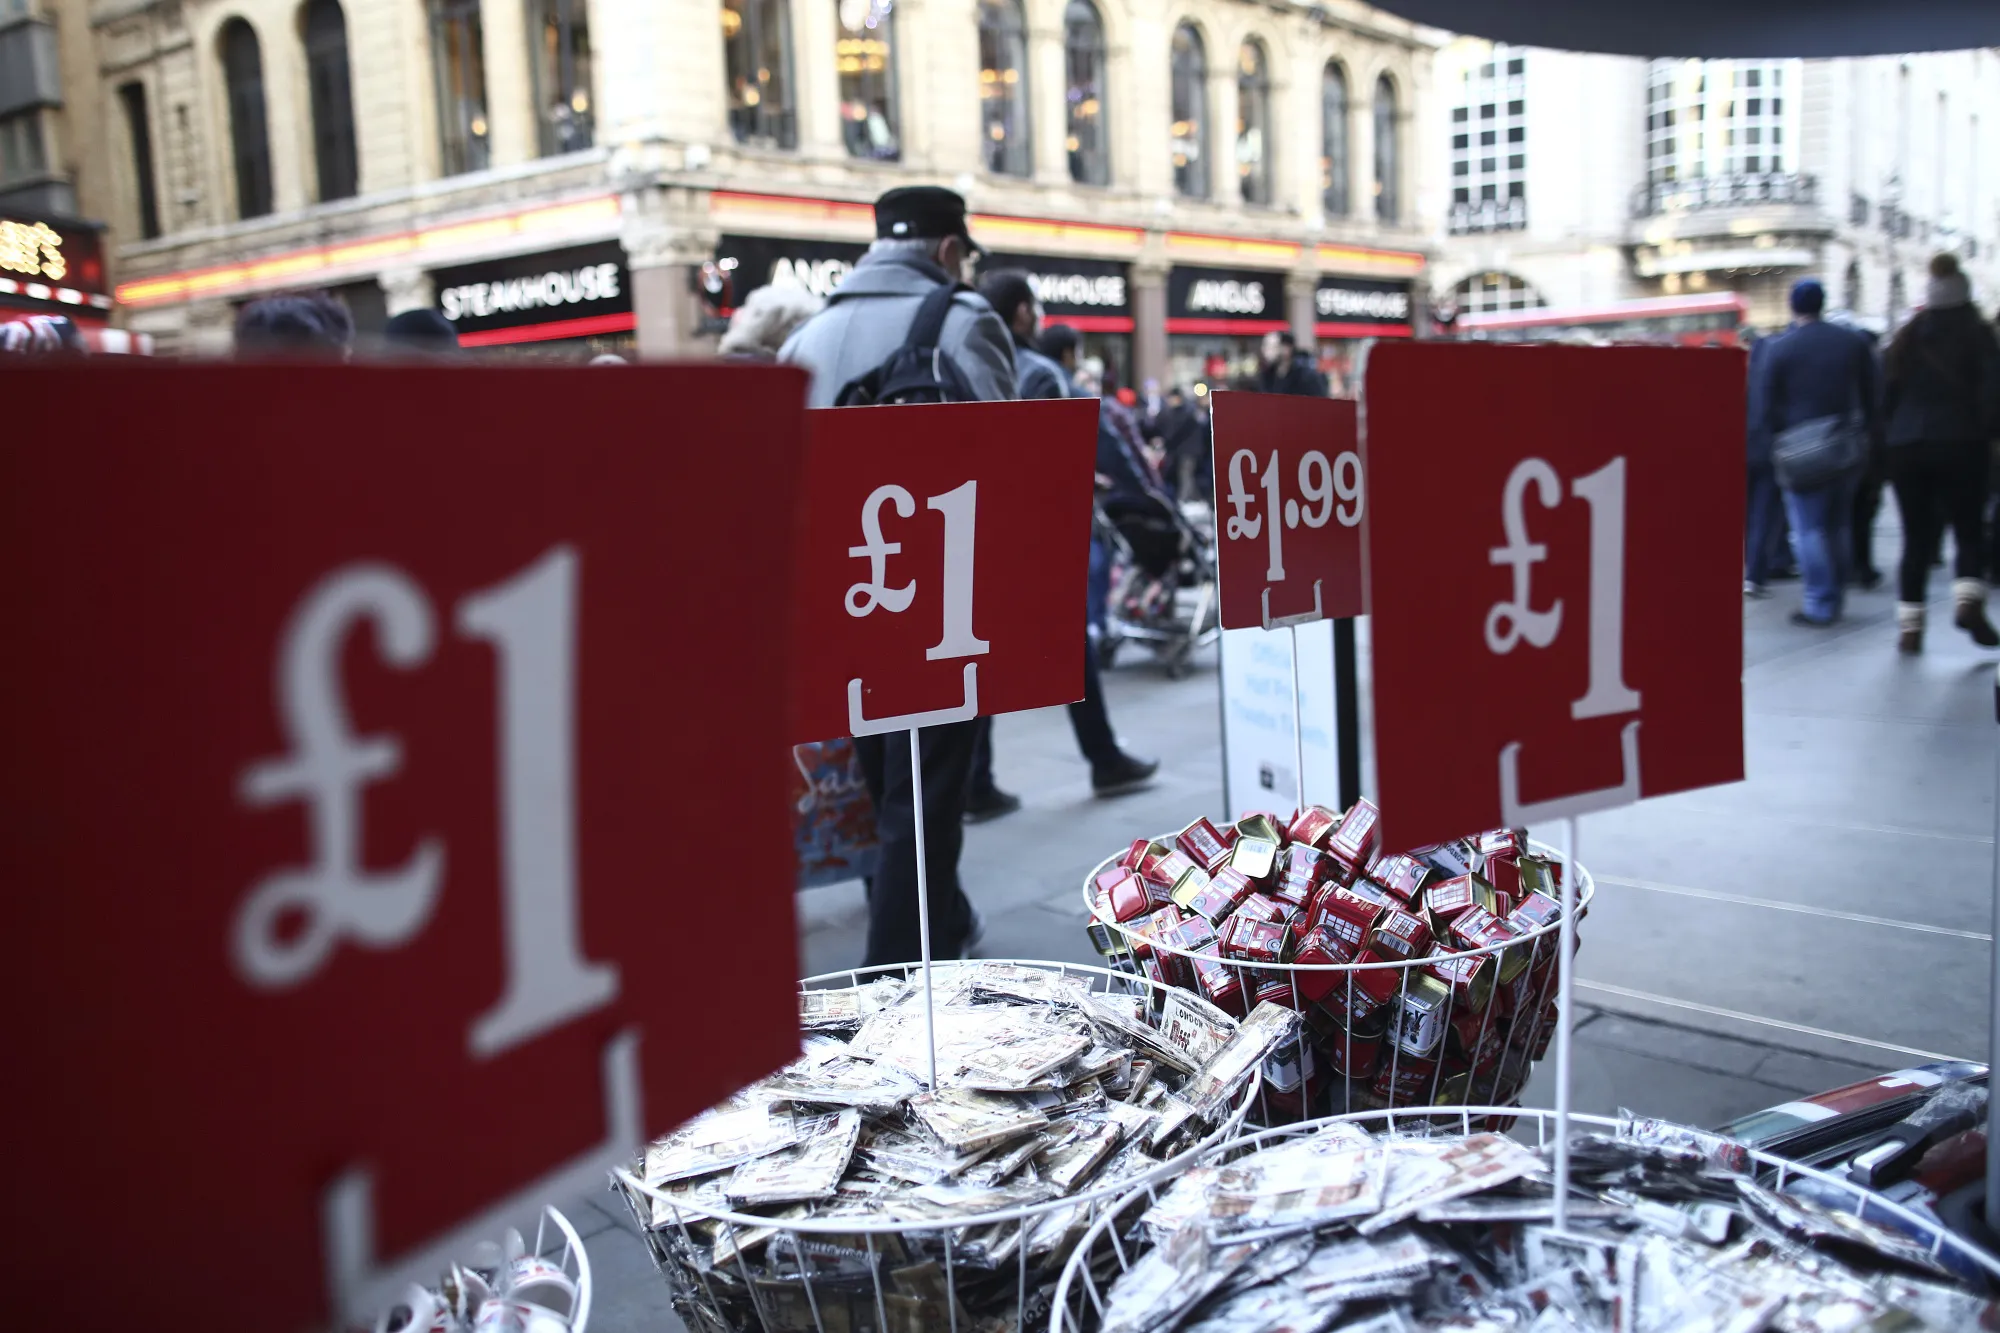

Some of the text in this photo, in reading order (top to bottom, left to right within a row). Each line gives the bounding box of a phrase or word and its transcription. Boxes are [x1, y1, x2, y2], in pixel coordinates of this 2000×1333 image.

[441, 263, 620, 320] STEAKHOUSE
[769, 257, 855, 298] ANG
[843, 479, 991, 662] £1
[1226, 448, 1365, 582] £1.99
[1483, 455, 1641, 719] £1
[233, 545, 621, 1057] £1
[1175, 1008, 1204, 1028] LONDON
